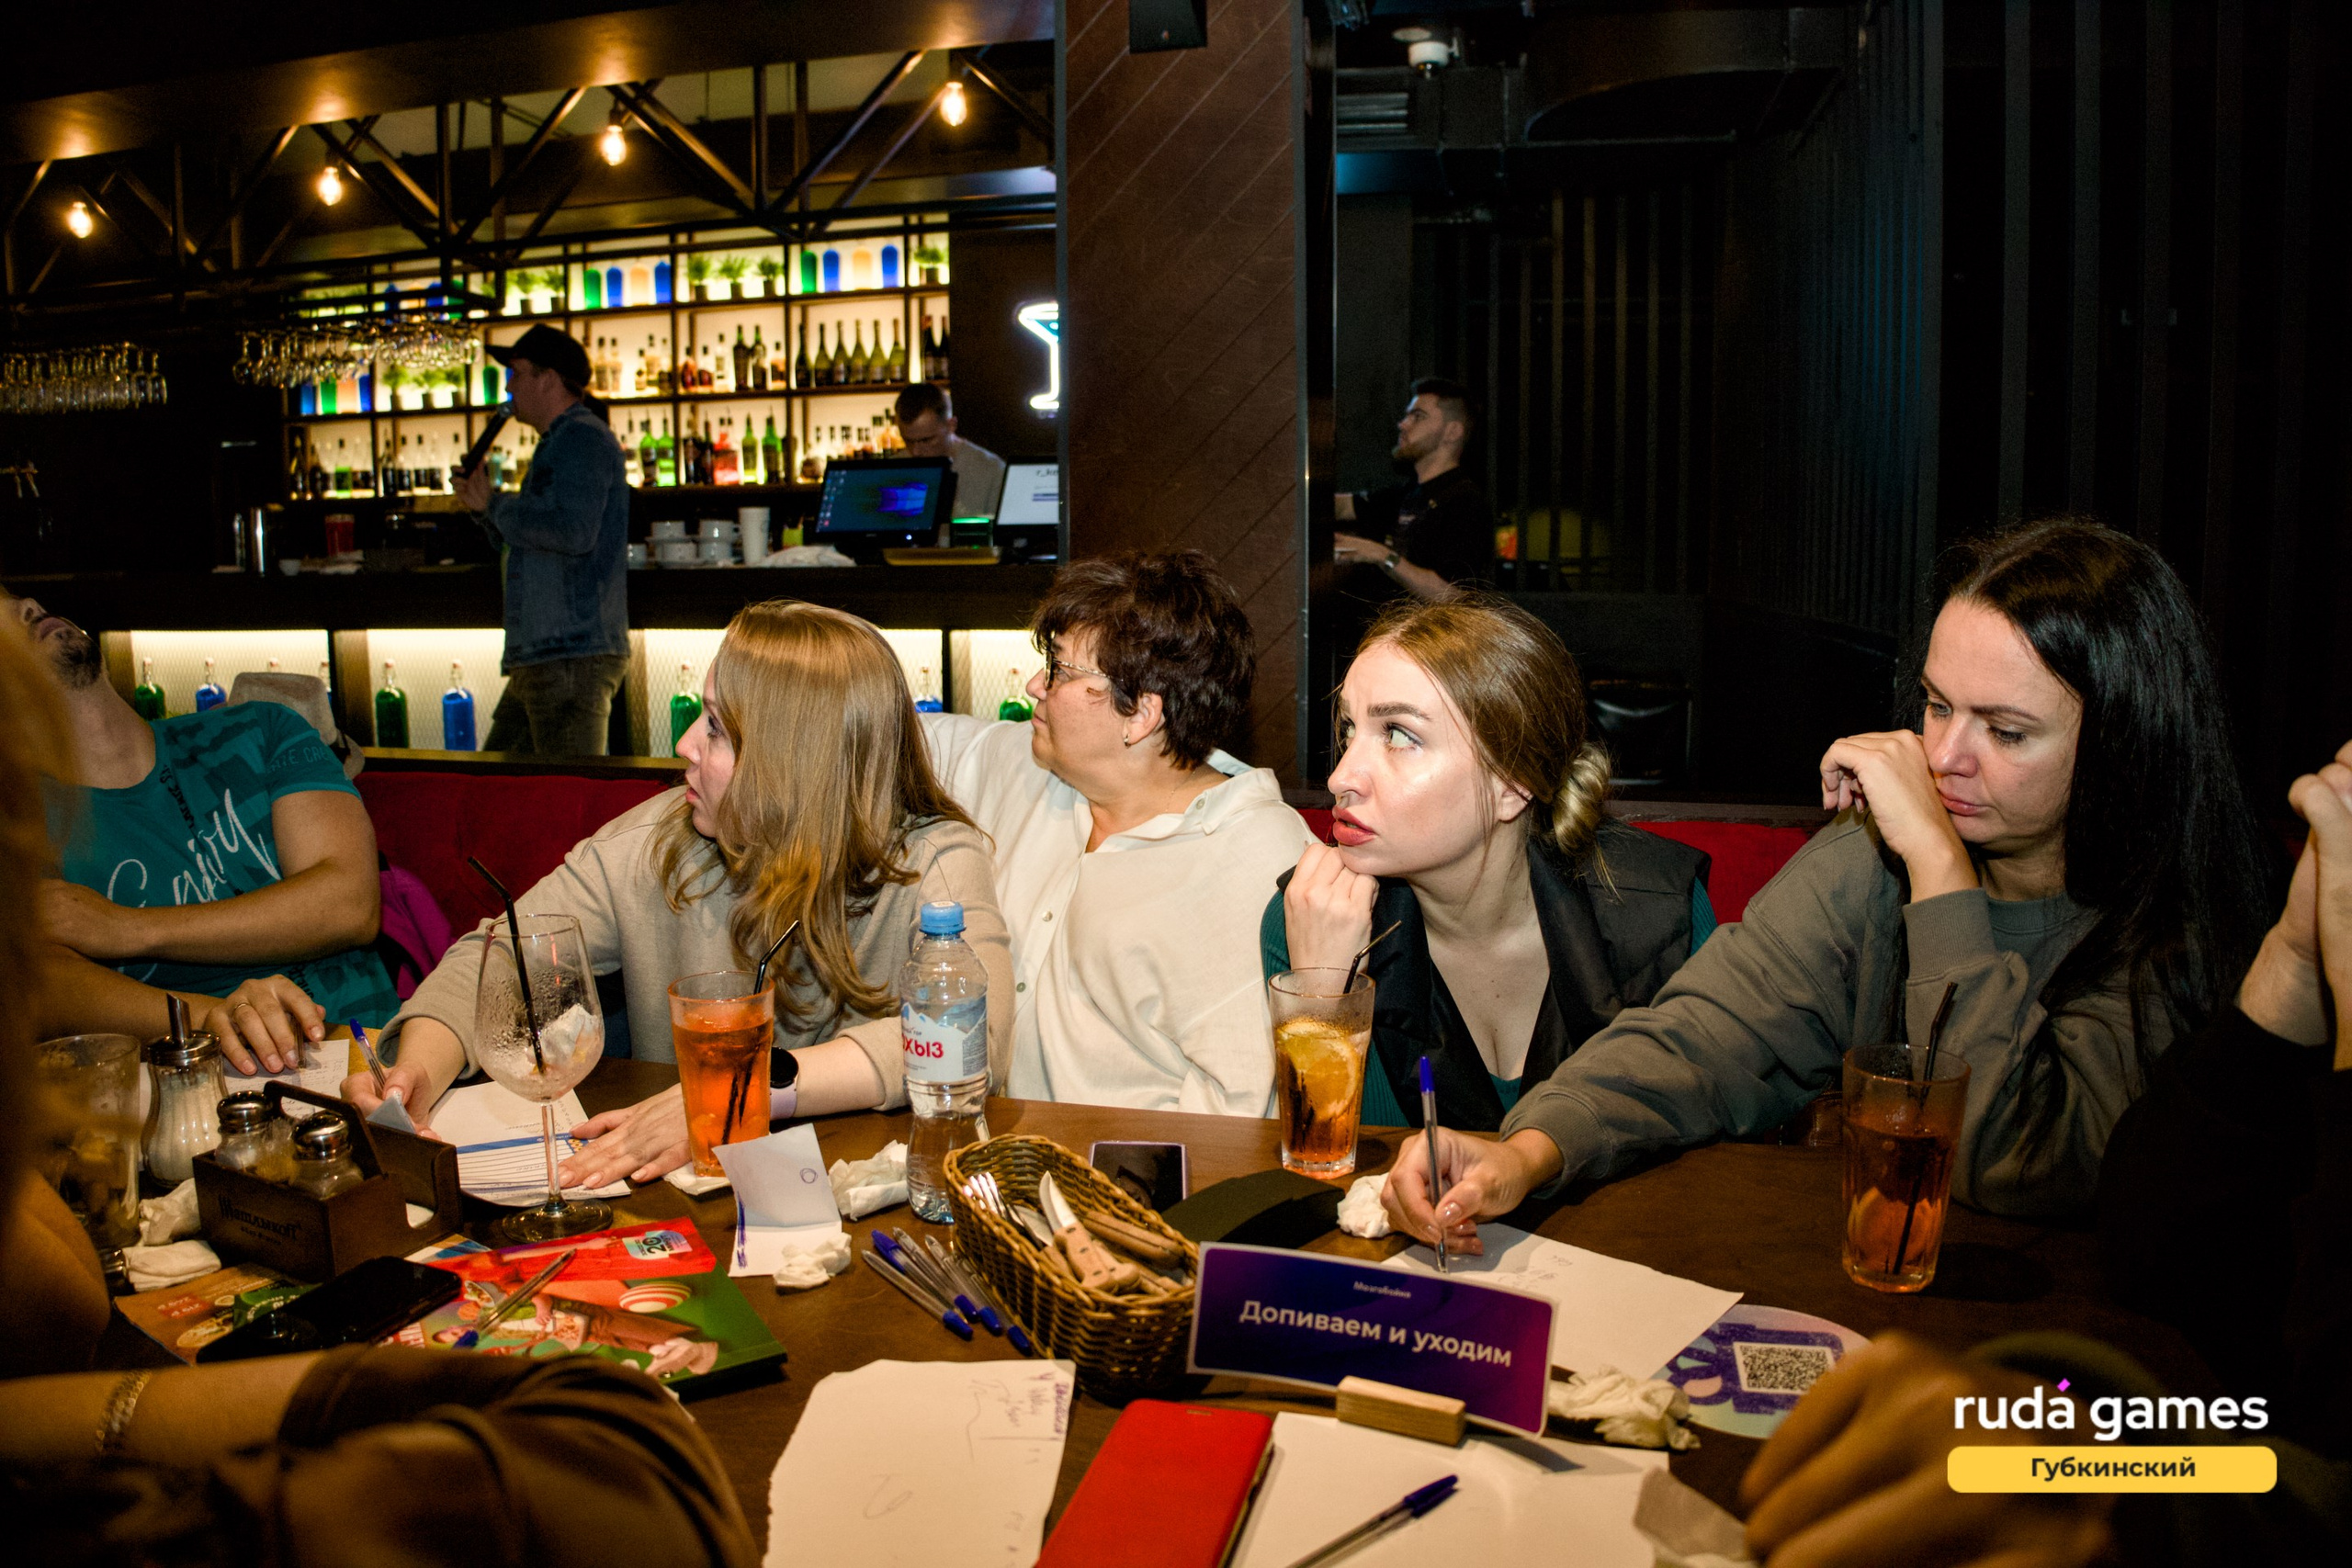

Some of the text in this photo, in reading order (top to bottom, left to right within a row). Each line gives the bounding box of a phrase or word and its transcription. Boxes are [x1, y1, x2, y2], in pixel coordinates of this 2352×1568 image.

[901, 1034, 944, 1058] ХЫЗ
[1238, 1301, 1512, 1368] Допиваем и уходим
